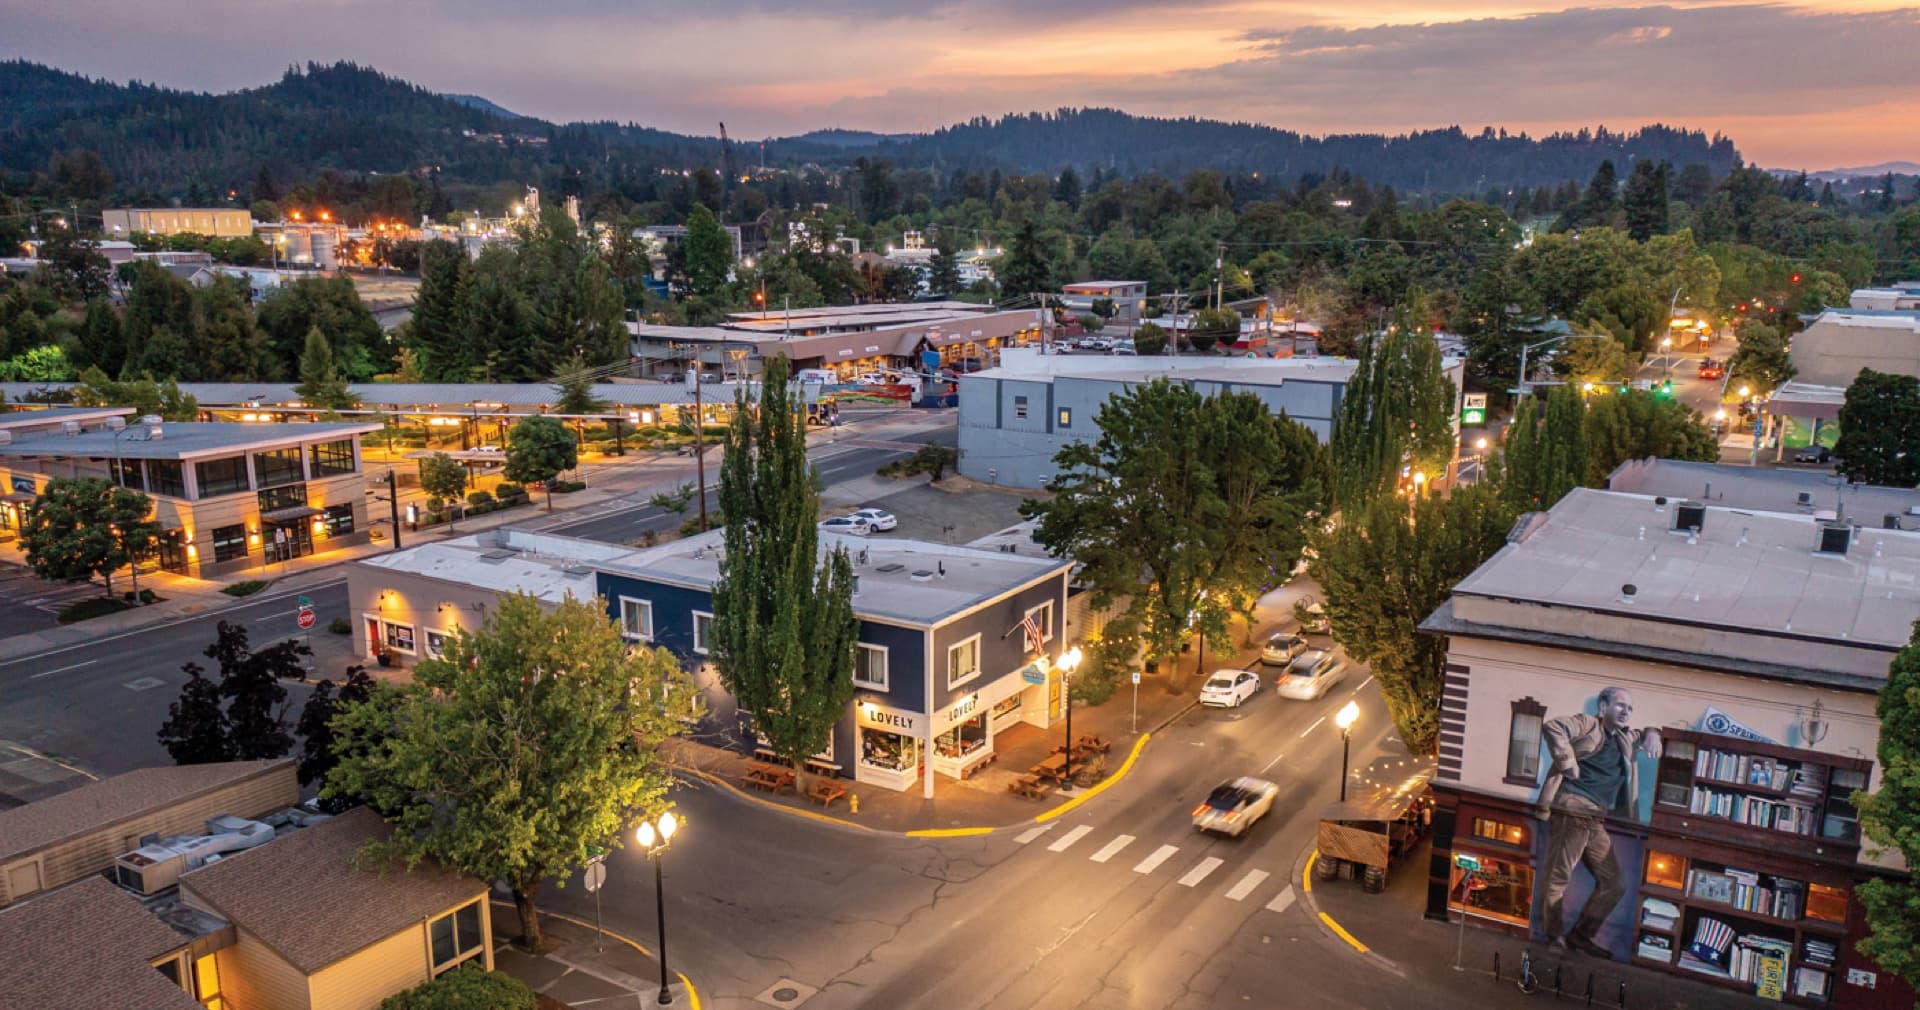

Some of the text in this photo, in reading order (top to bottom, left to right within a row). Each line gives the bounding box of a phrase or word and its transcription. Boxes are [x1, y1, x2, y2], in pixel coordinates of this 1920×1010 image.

[299, 613, 315, 625] STOP
[870, 710, 913, 729] LOVELY
[949, 700, 976, 721] LOVELY
